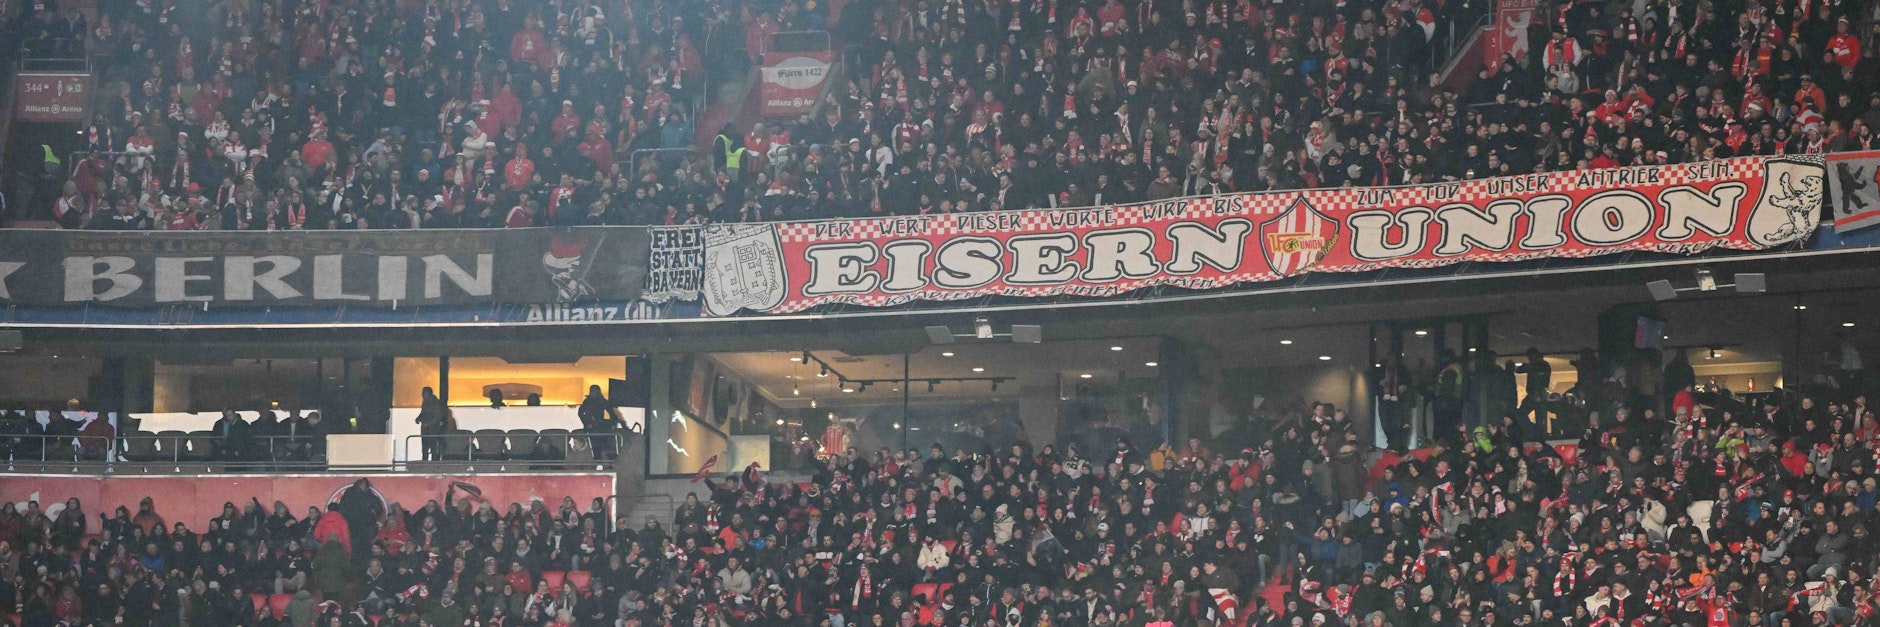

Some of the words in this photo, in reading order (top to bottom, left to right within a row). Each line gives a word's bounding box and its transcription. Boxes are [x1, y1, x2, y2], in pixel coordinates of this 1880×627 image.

[25, 83, 42, 92] 344
[25, 105, 50, 113] Allianz
[61, 105, 82, 113] Arena
[816, 222, 851, 237] DER
[880, 218, 930, 236] WERT
[957, 214, 1022, 231] DIESER
[1050, 208, 1115, 227] WORTE
[1143, 201, 1188, 219] WIRD
[1214, 196, 1242, 214] BIS
[1357, 190, 1396, 205] ZUM
[1425, 184, 1460, 200] TOD
[1487, 175, 1549, 195] UNSER
[1577, 168, 1660, 187] ANTRIEB
[652, 227, 701, 248] FREI
[804, 220, 1251, 294] EISERN
[1349, 183, 1747, 261] UNION
[1300, 239, 1323, 250] UNION
[652, 249, 701, 269] STATT
[63, 253, 493, 302] BERLIN
[653, 268, 699, 293] BAYERN
[526, 303, 618, 322] Allianz
